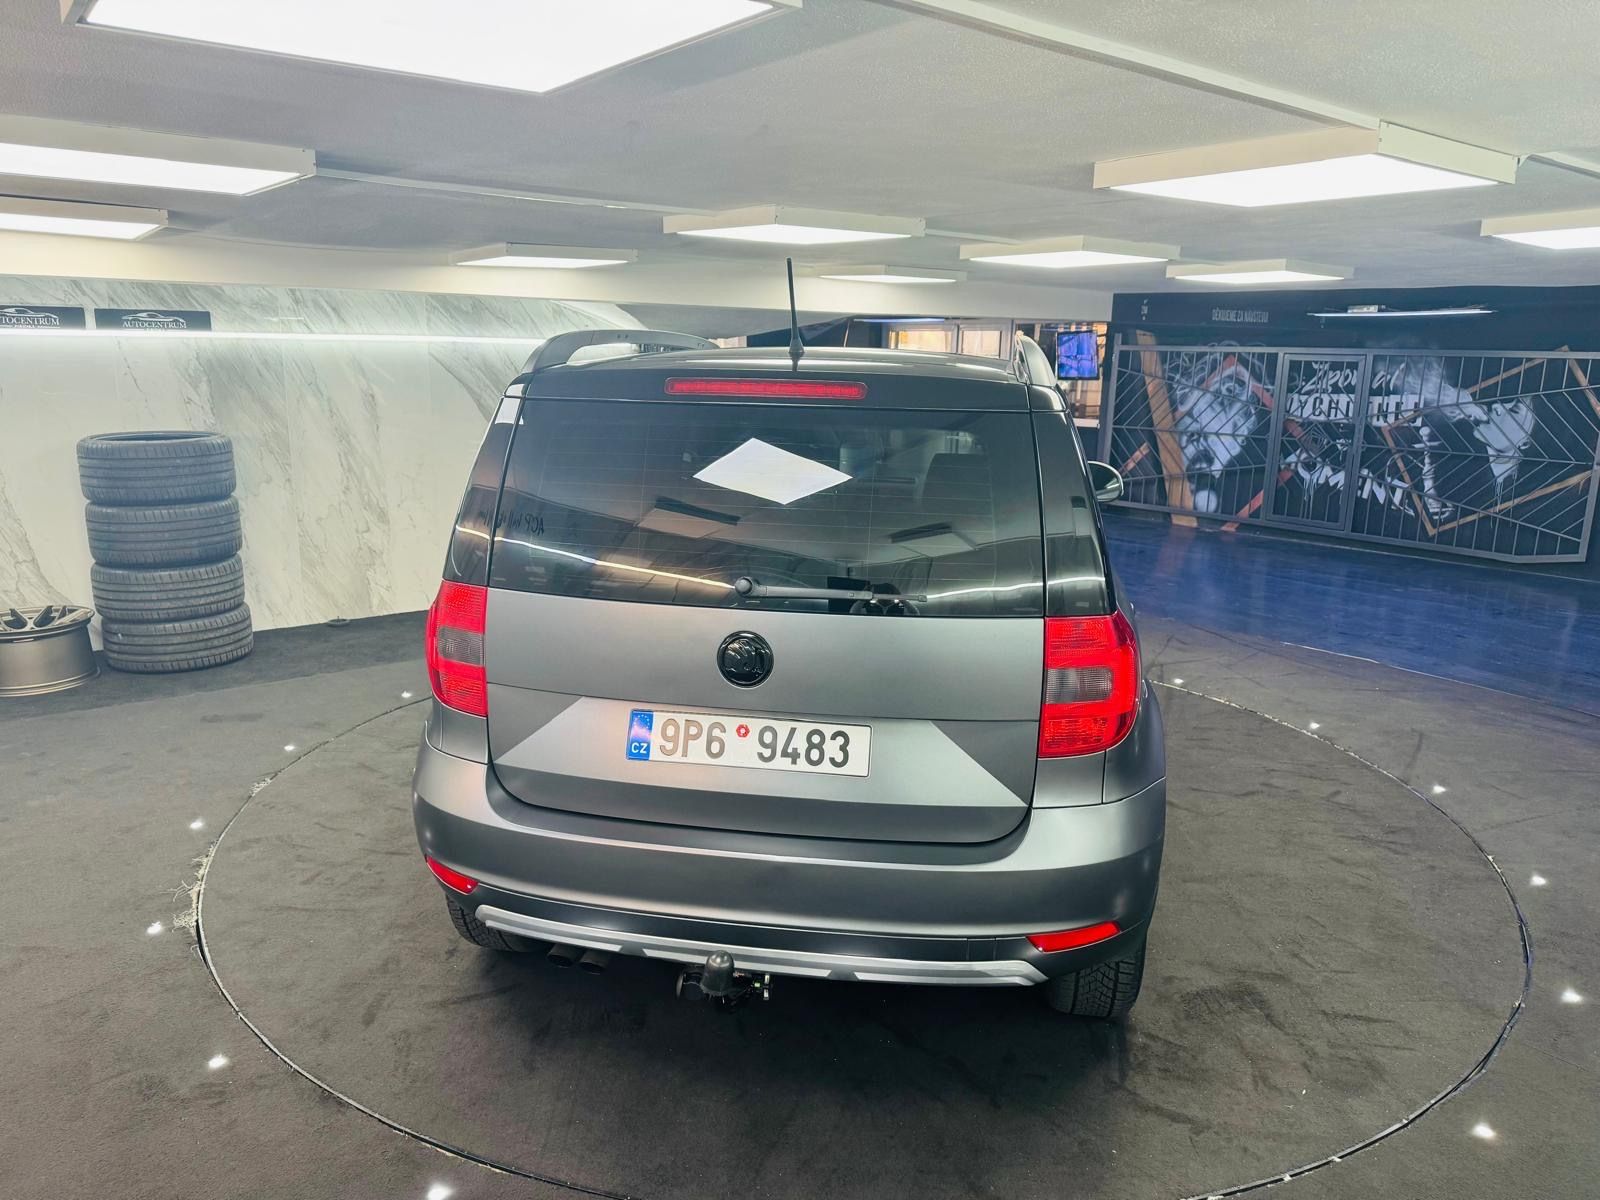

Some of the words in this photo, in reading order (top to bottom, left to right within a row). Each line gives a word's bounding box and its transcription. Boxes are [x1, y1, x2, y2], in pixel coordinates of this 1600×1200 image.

[0, 316, 60, 326] TOCENTRUM
[122, 320, 187, 329] AUTOCENTRUM
[1301, 360, 1405, 393] Zpoal
[1286, 396, 1419, 424] VYCHNEJ
[1280, 448, 1409, 507] OMNT
[631, 742, 648, 754] CZ
[659, 717, 727, 760] 9P6
[756, 725, 851, 769] 9483
